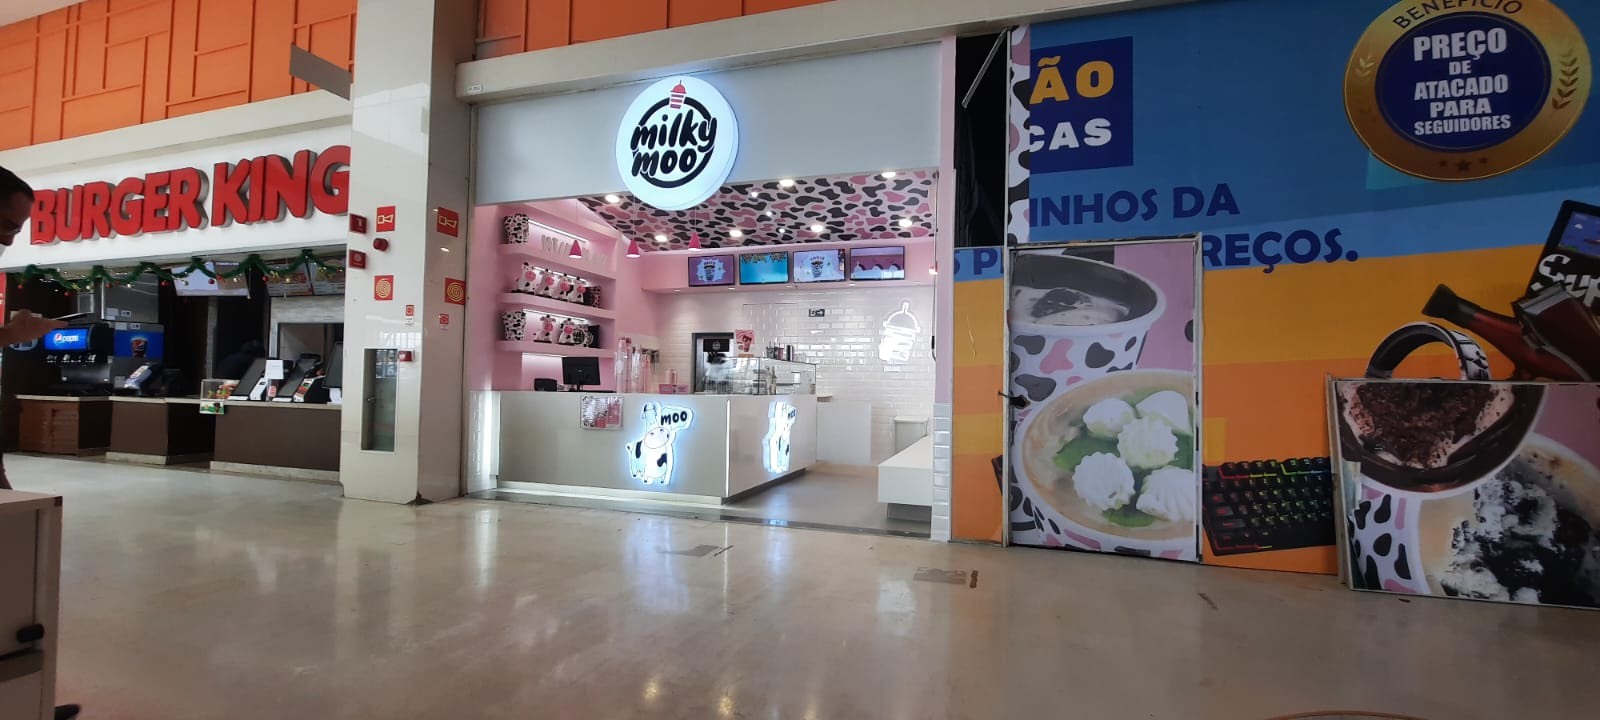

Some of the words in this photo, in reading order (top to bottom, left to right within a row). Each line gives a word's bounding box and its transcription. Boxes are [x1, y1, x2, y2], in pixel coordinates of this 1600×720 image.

[1413, 28, 1508, 61] PREÇO
[1029, 55, 1115, 105] ÃO
[1449, 60, 1472, 75] DE
[1414, 74, 1509, 100] ATACADO
[1429, 98, 1492, 118] PARA
[630, 109, 718, 152] milky
[1414, 114, 1511, 136] SEGUIDORES
[631, 148, 697, 177] moo
[31, 167, 207, 245] BURGER
[211, 145, 351, 229] KING
[1173, 183, 1240, 219] DA
